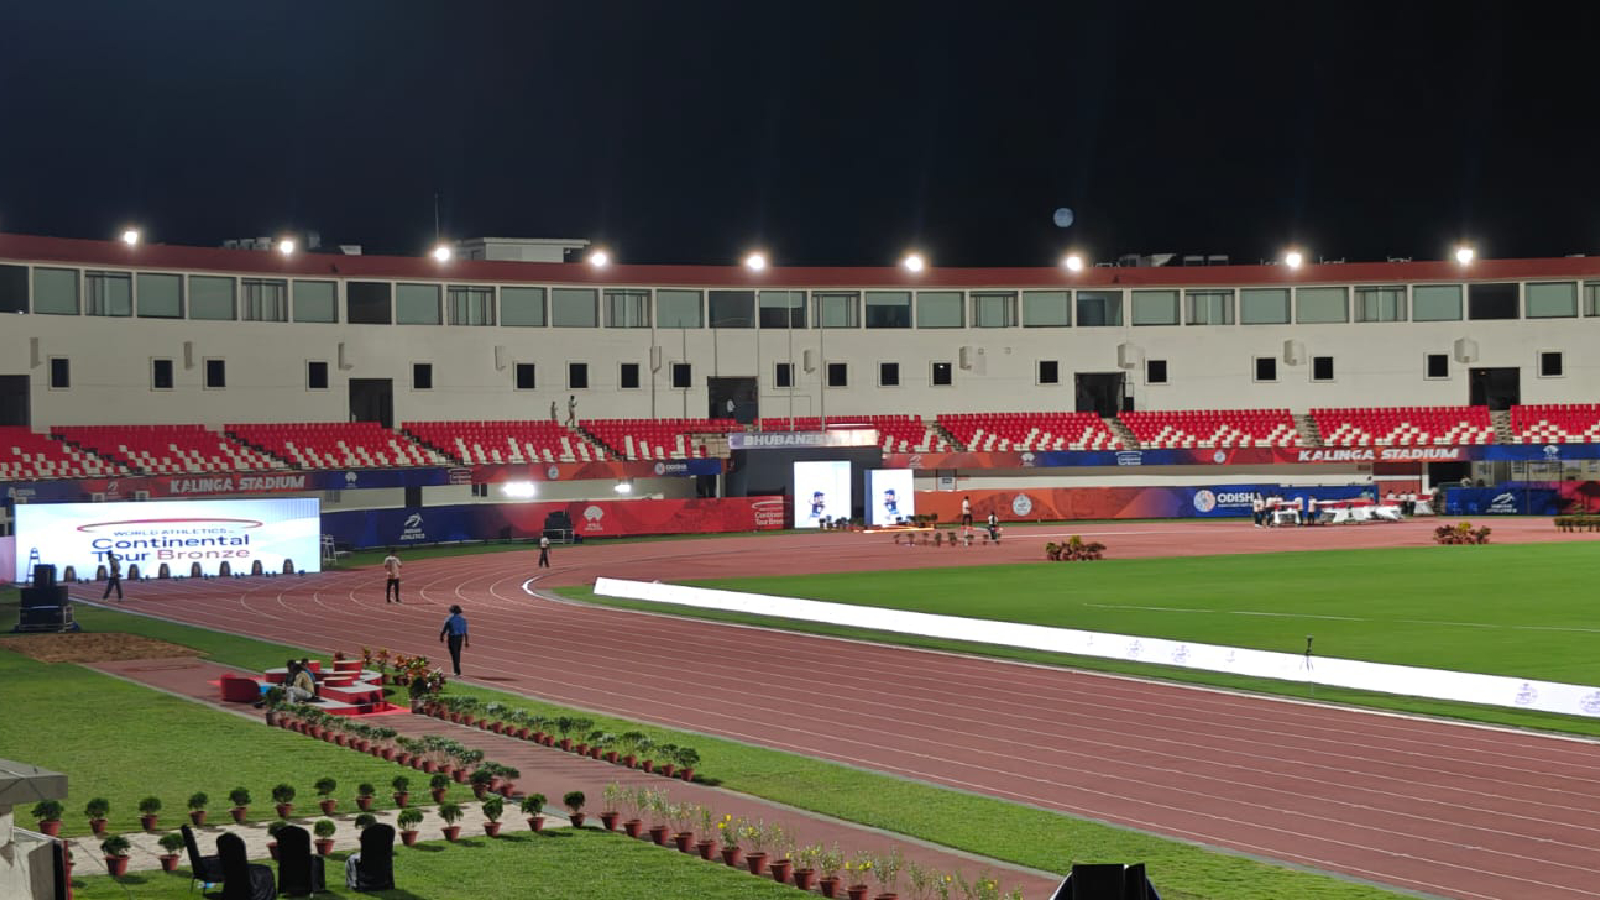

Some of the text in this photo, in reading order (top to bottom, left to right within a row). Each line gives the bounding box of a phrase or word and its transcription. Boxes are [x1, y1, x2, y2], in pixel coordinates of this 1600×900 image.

[1298, 448, 1459, 461] KALINGA STADIUM
[170, 475, 305, 493] KALINGA STADIUM
[92, 534, 250, 550] Continental
[157, 549, 250, 560] Bronze
